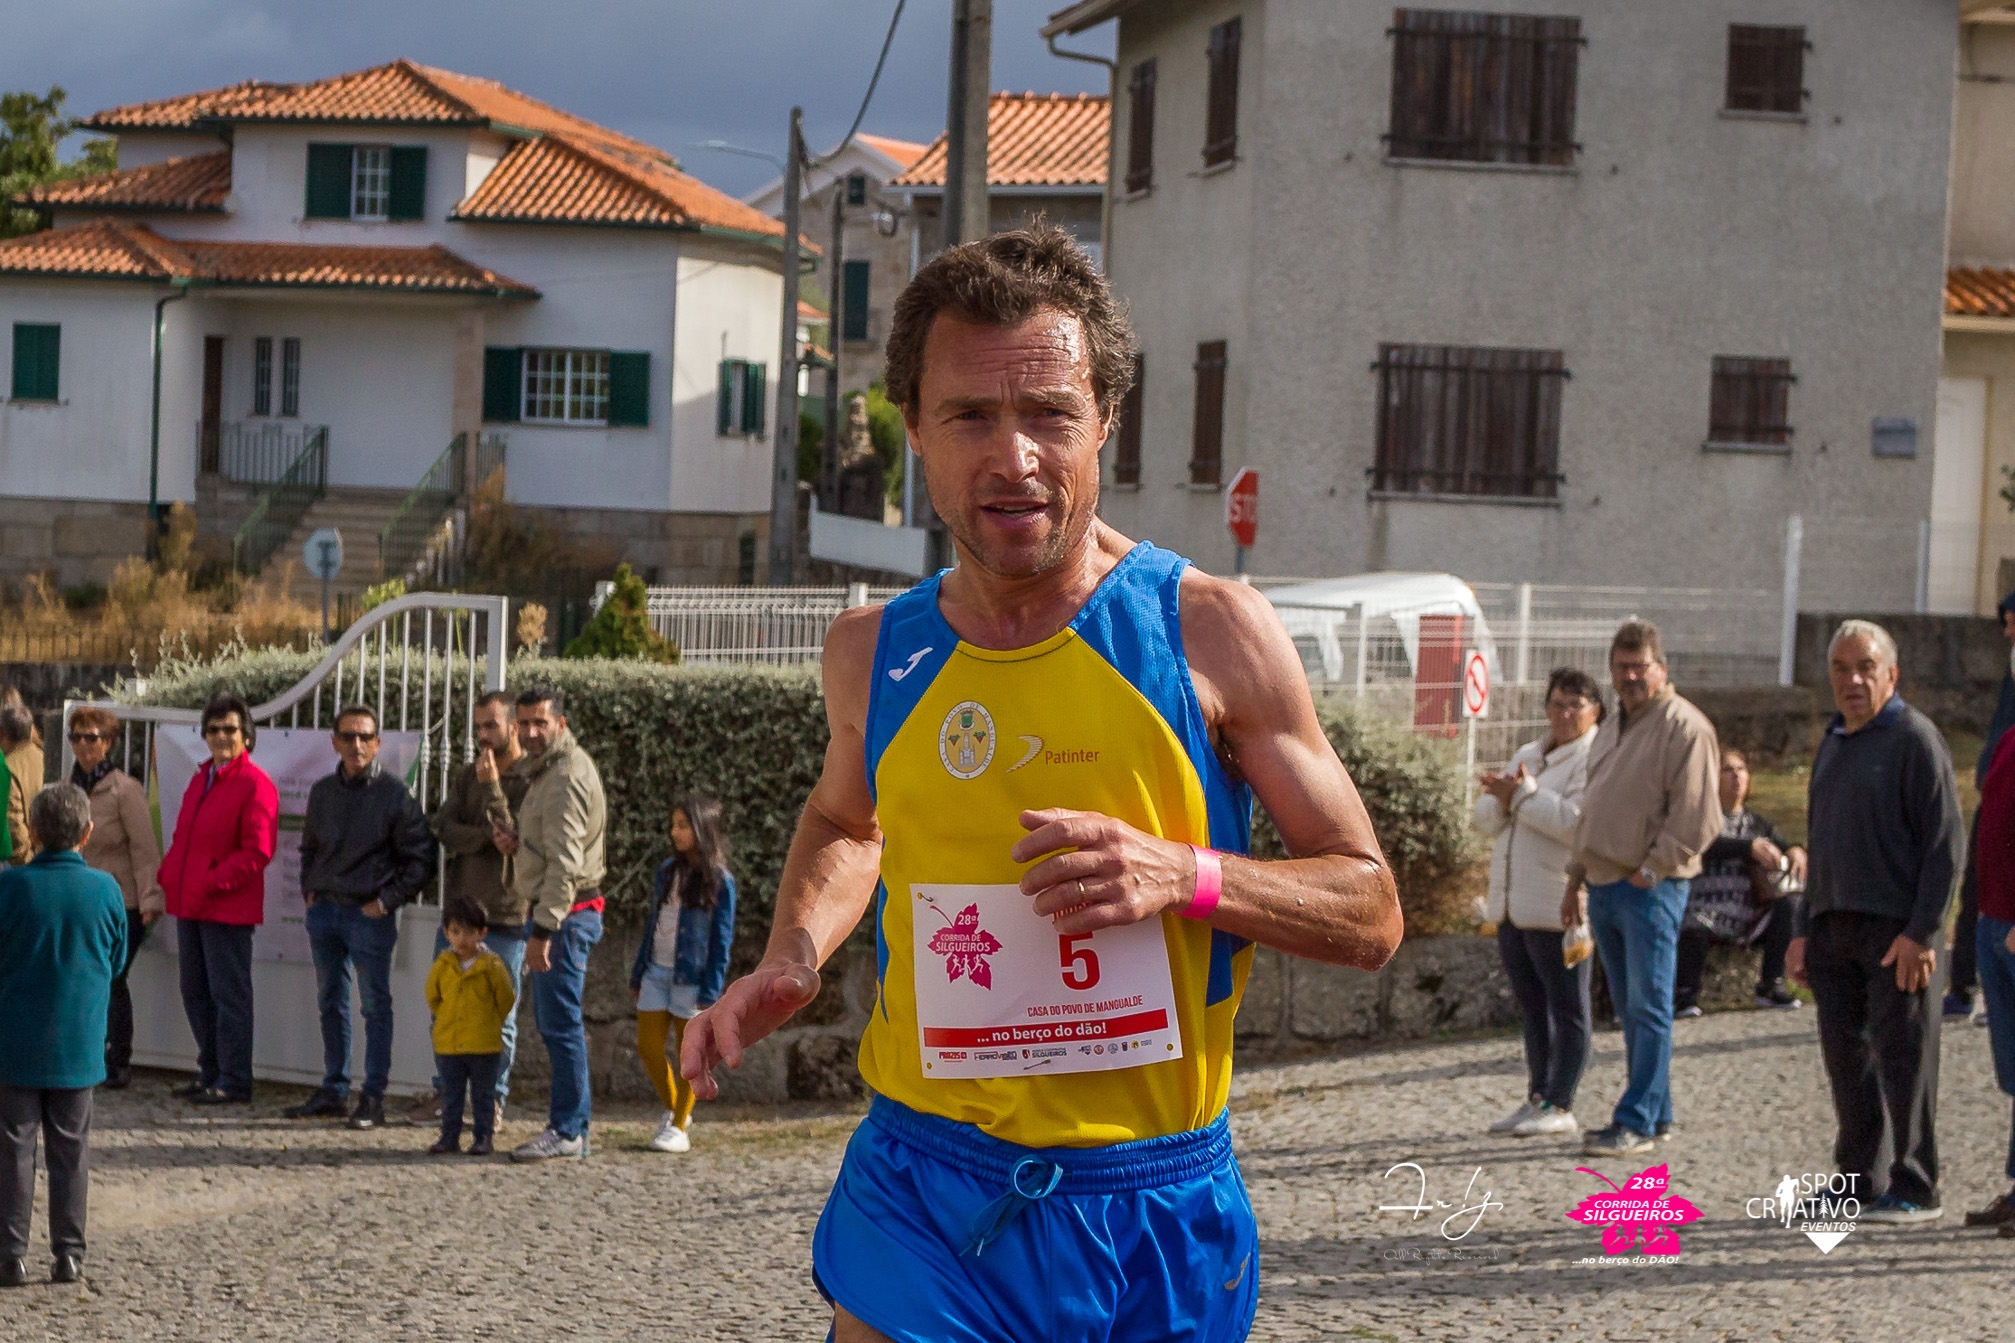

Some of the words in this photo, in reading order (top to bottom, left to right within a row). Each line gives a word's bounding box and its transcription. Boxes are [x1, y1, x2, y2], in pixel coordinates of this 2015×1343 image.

[1045, 748, 1100, 765] Patinter
[935, 941, 991, 952] SILGUEIROS
[940, 933, 970, 942] CORRIDA
[971, 933, 981, 942] DE
[1058, 931, 1100, 990] 5
[1027, 1006, 1049, 1017] CASA
[1050, 1005, 1061, 1016] DO
[1062, 1003, 1083, 1015] POVO
[1084, 1002, 1095, 1013] DE
[1096, 995, 1143, 1012] MANGUALDE
[992, 1031, 1010, 1042] no
[1013, 1027, 1052, 1042] berço
[1054, 1024, 1073, 1037] do
[1075, 1021, 1107, 1036] dão!
